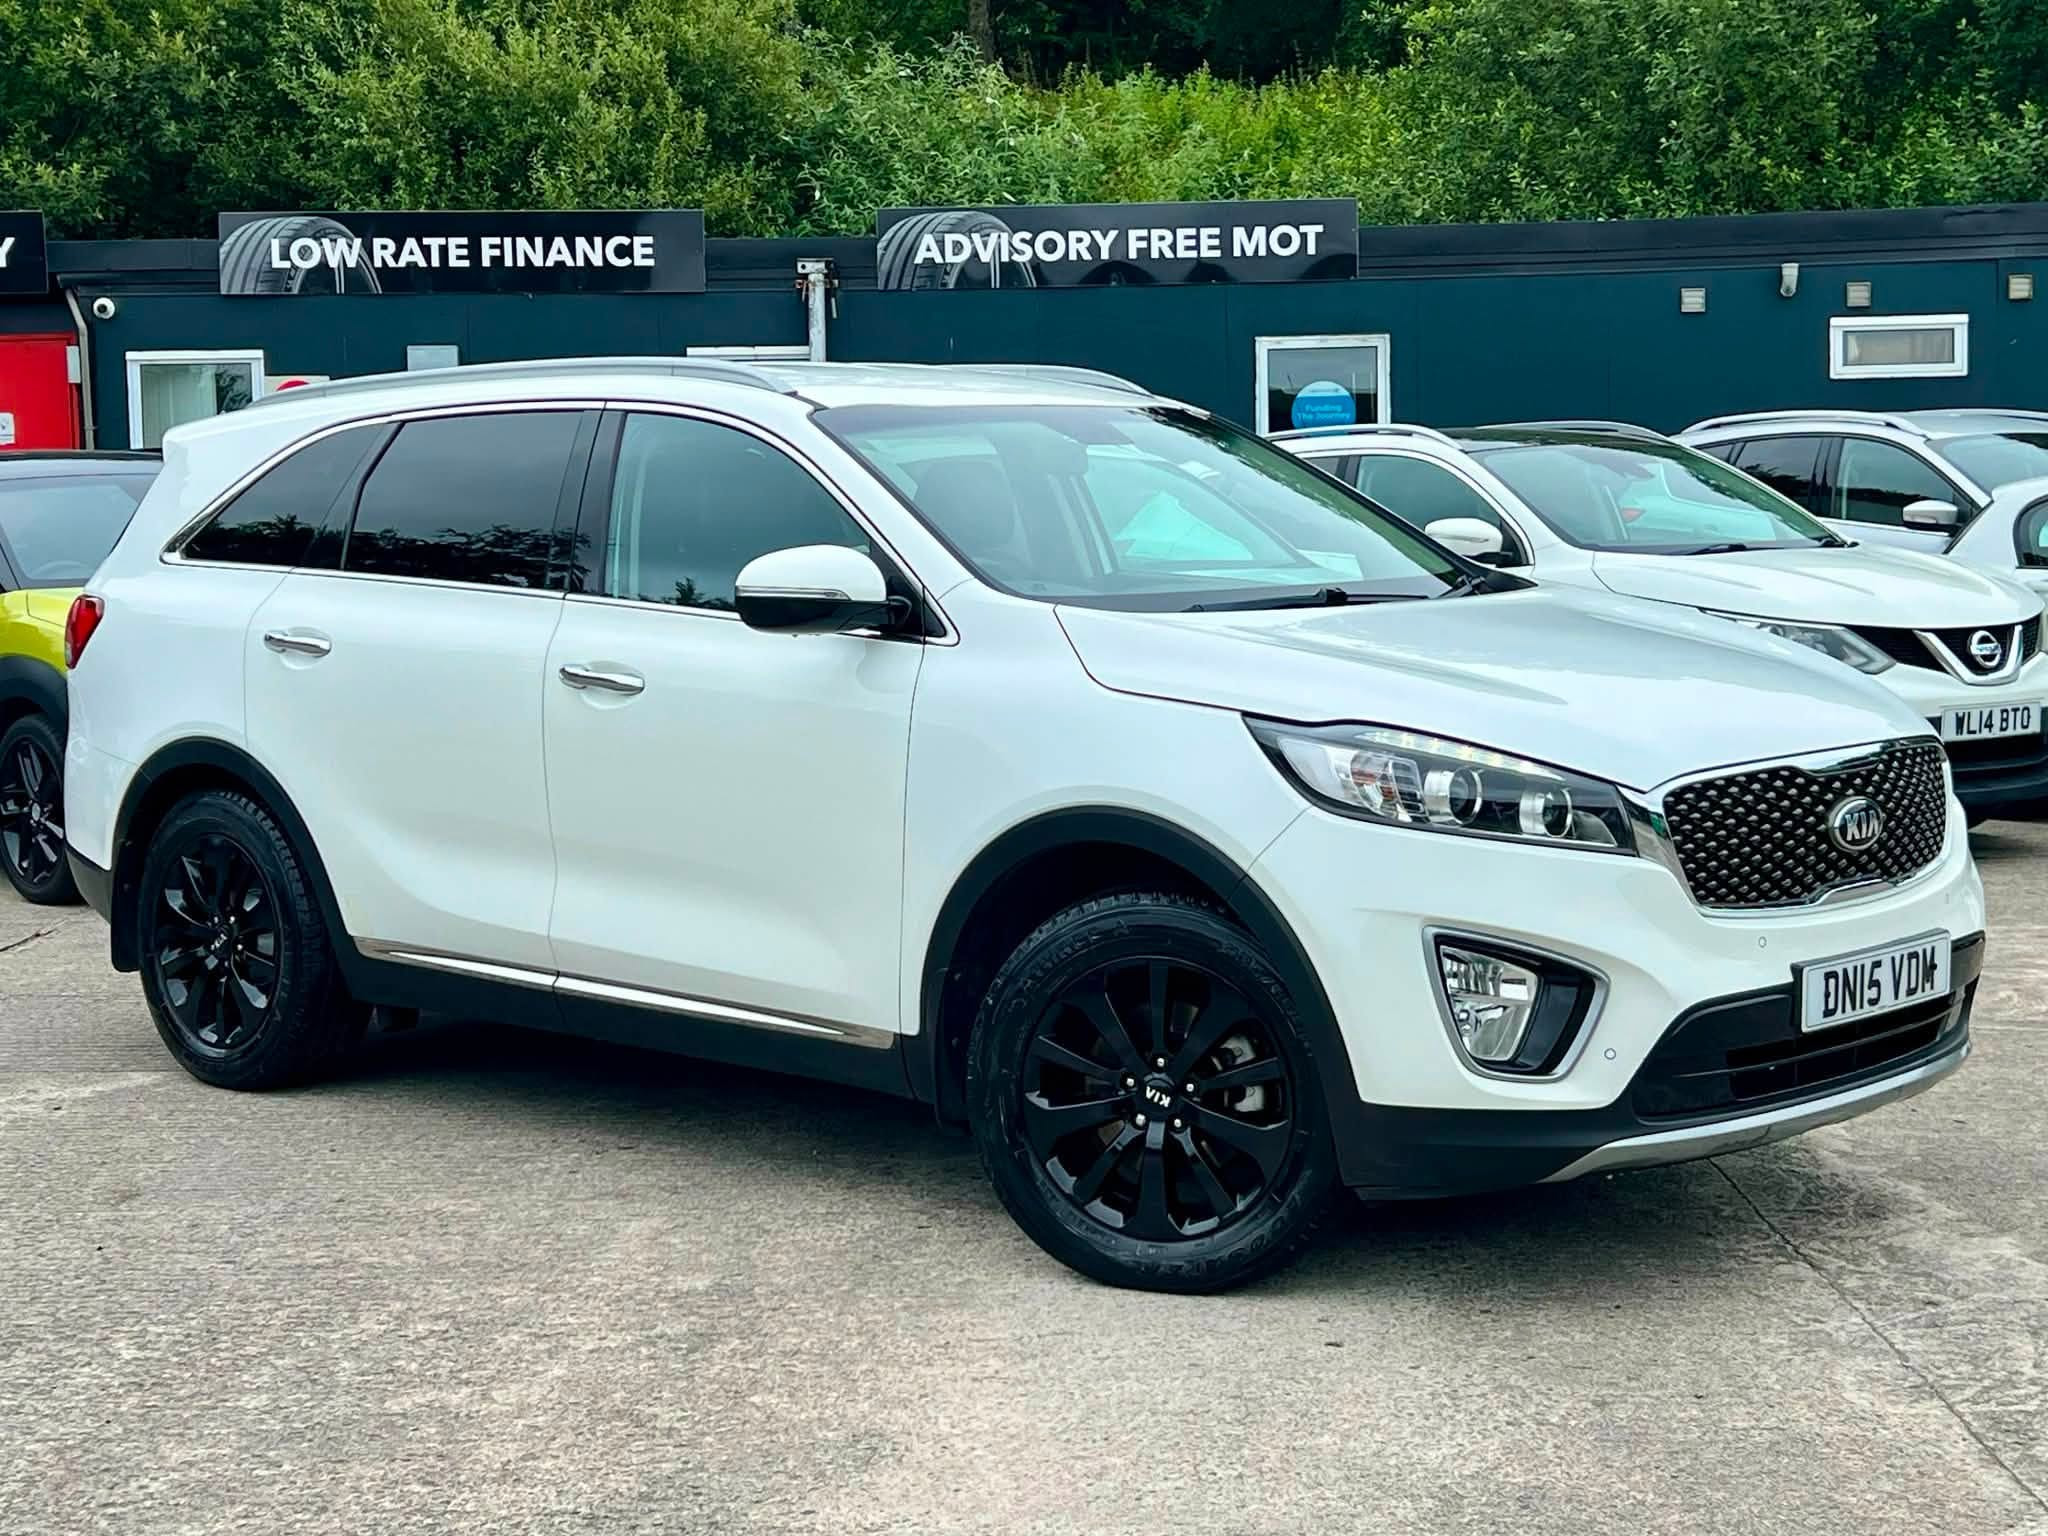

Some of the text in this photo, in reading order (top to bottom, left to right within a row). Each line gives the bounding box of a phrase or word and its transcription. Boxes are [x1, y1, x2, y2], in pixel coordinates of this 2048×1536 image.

[270, 236, 655, 269] LOW RATE FINANCE
[914, 225, 1324, 264] ADVISORY FREE MOT
[1955, 706, 2032, 736] WL14 BTO
[1845, 810, 1880, 841] KIA
[1822, 946, 1938, 1019] DN15 VDM
[1146, 1086, 1171, 1108] KIA
